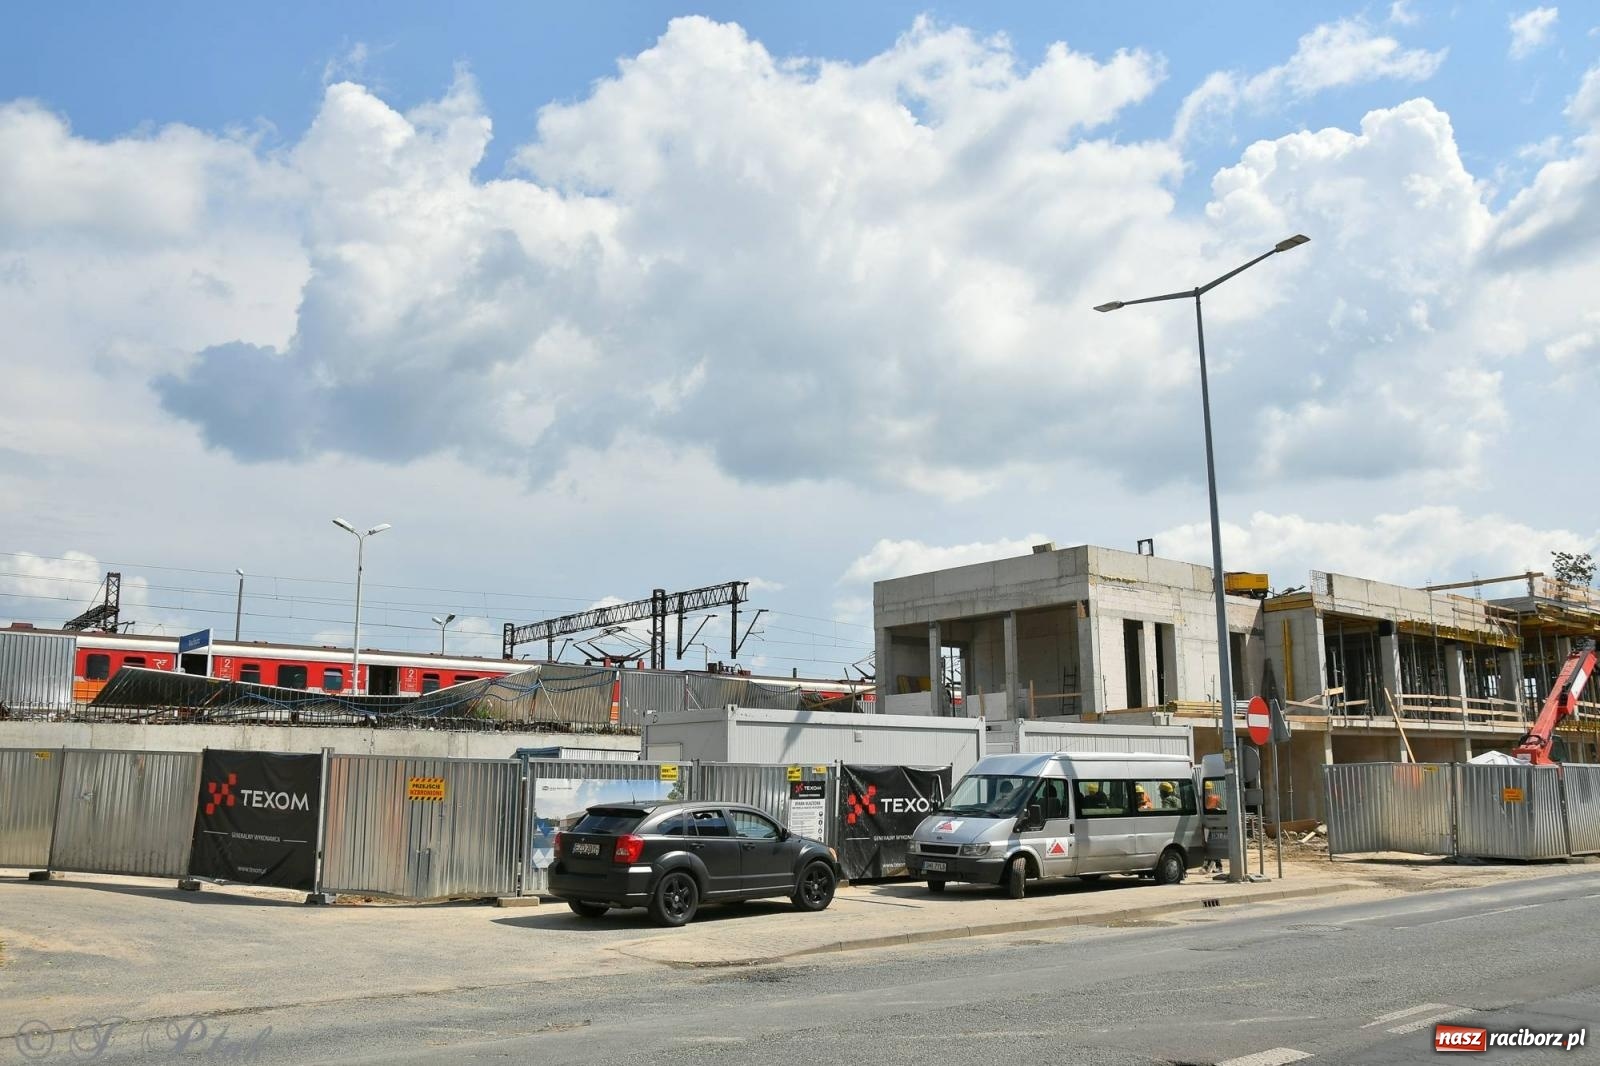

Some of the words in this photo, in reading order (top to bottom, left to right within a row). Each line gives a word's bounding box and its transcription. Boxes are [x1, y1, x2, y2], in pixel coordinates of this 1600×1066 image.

[224, 659, 231, 668] 2
[408, 669, 415, 678] 2
[240, 789, 309, 811] TEXOM
[880, 797, 931, 812] TEXO
